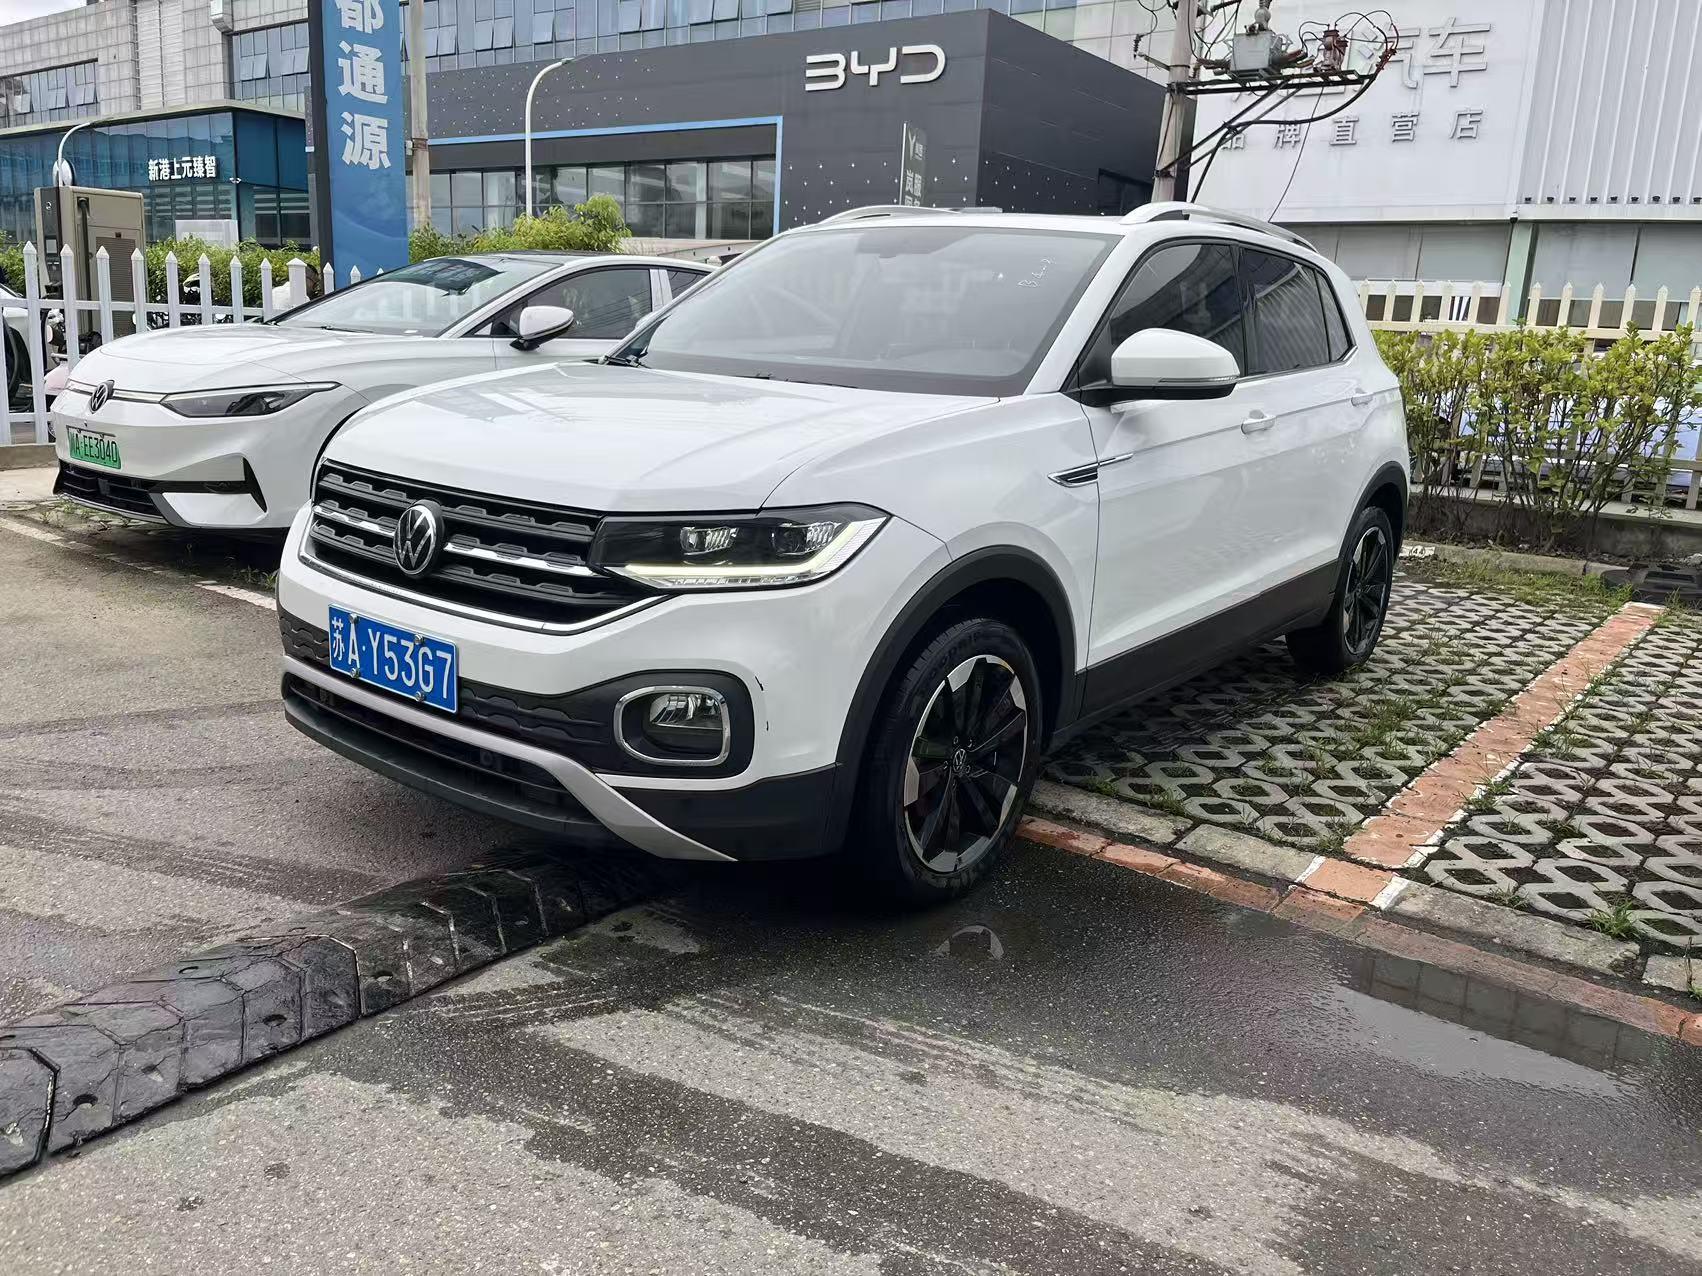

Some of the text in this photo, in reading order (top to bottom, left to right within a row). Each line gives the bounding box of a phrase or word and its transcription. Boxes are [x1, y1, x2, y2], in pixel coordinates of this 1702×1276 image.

[805, 44, 946, 91] BYD
[148, 155, 216, 181] 新港上元臻智
[331, 615, 453, 699] 苏A·Y53G7
